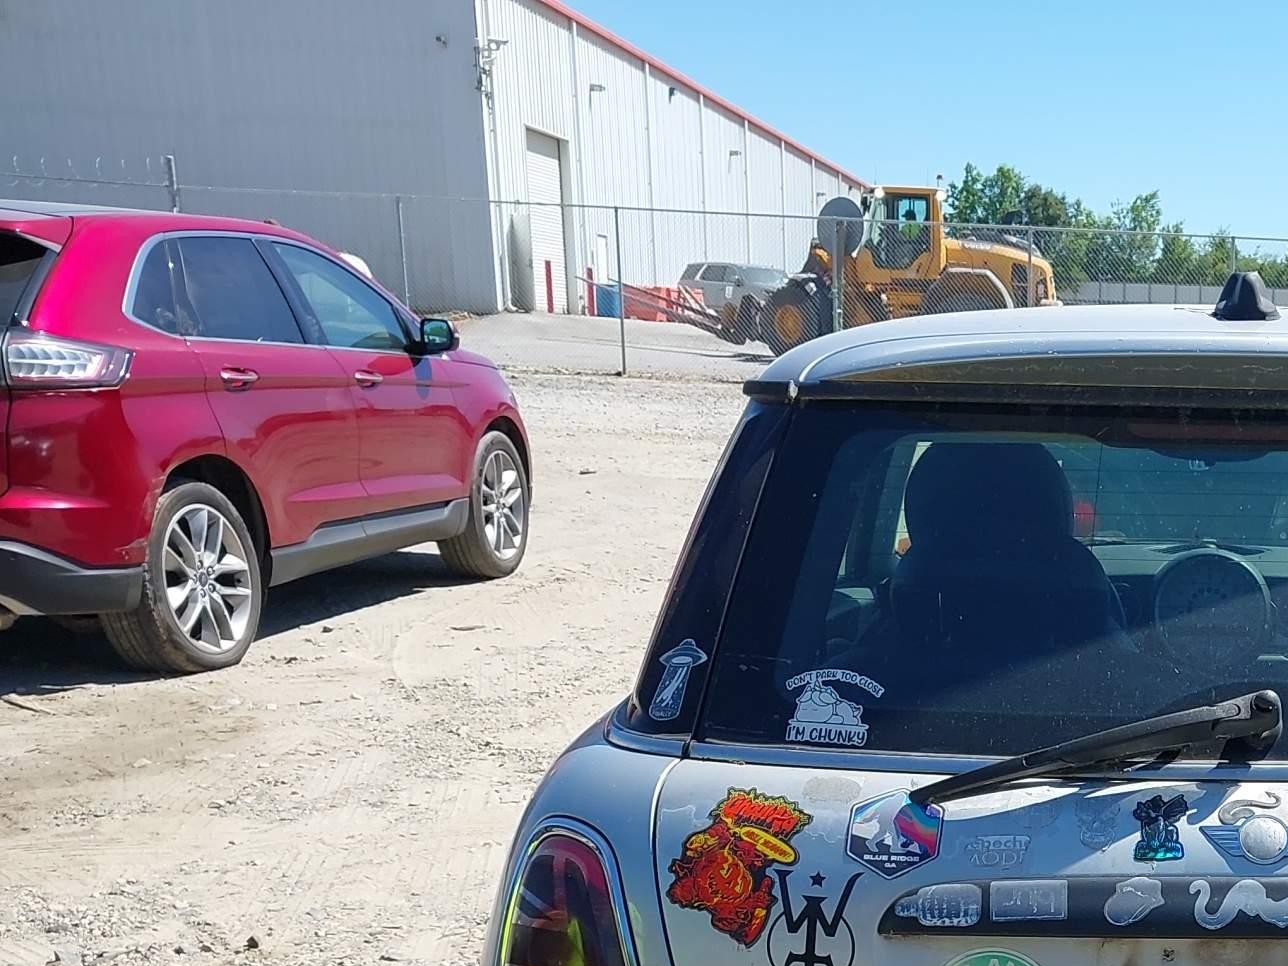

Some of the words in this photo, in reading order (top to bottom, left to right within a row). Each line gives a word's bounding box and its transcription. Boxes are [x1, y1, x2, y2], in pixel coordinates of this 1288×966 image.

[787, 672, 815, 688] DON'T
[815, 670, 838, 680] PARK
[839, 671, 858, 682] TOO
[858, 677, 884, 697] CLOSE
[786, 725, 806, 740] I'M
[809, 727, 866, 745] CHUNKY
[863, 854, 889, 862] BLUE
